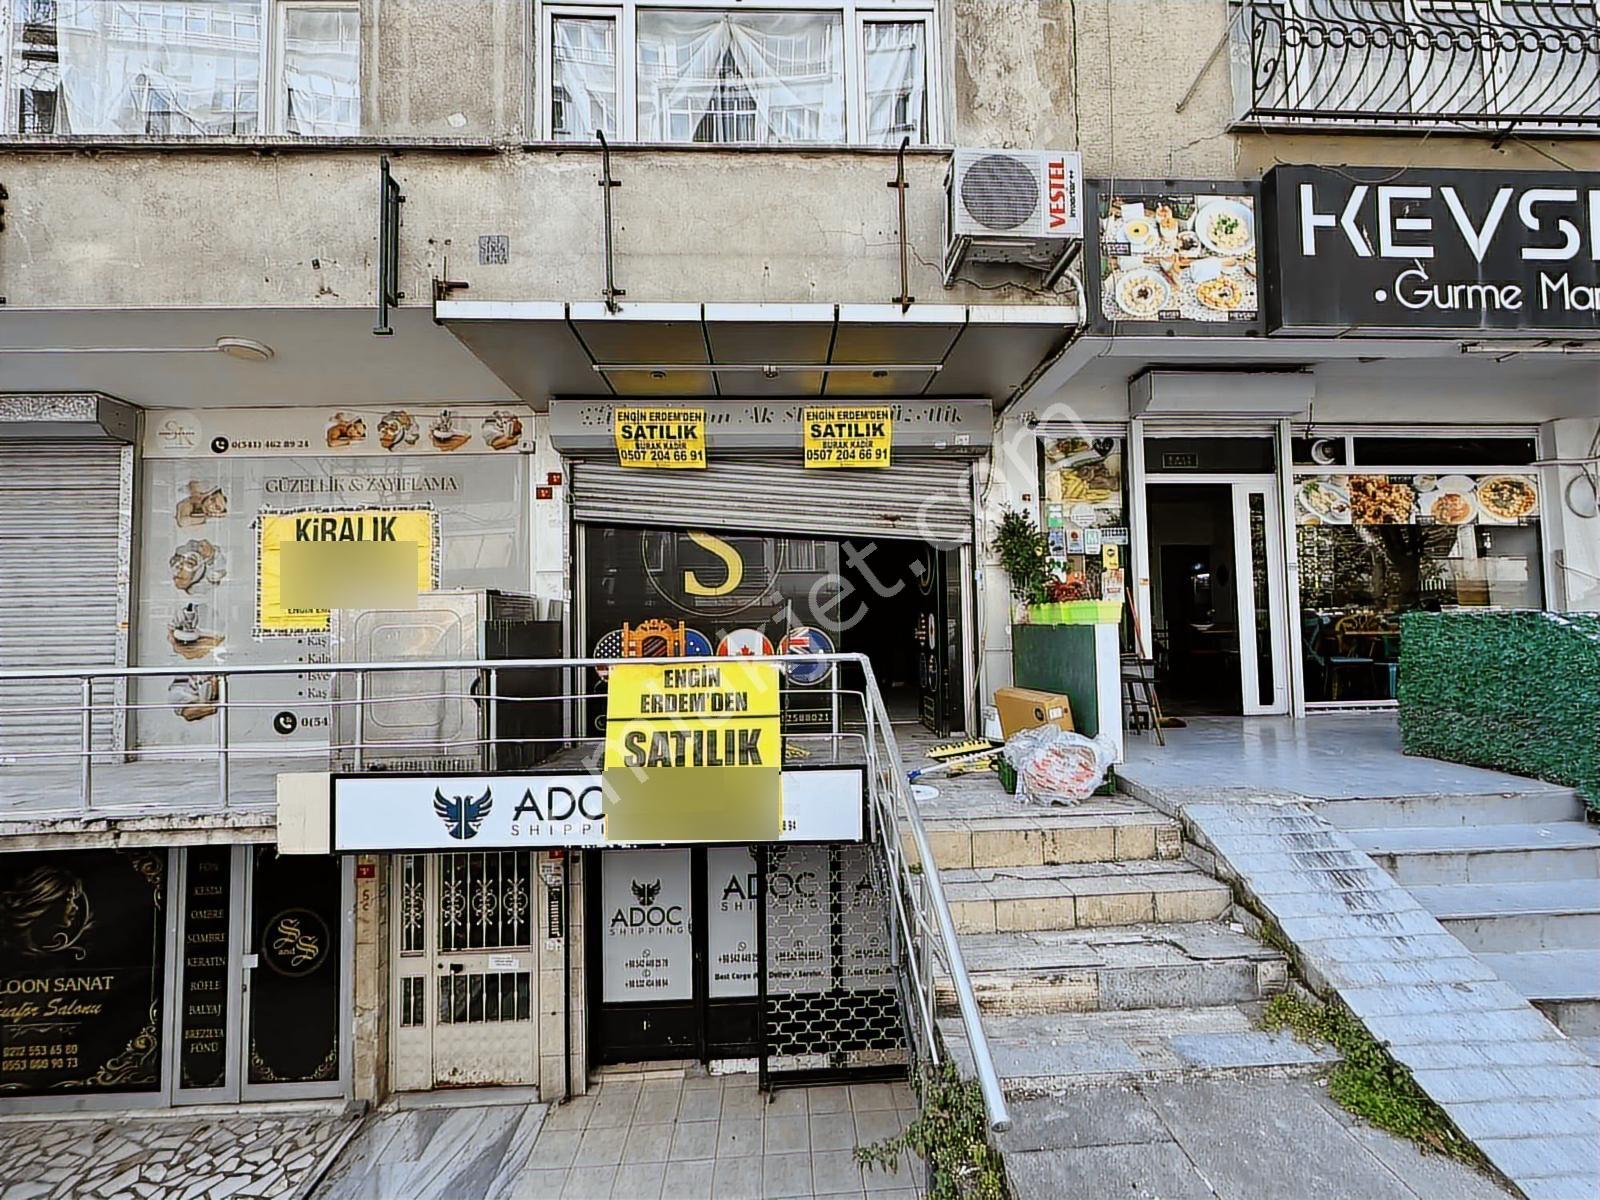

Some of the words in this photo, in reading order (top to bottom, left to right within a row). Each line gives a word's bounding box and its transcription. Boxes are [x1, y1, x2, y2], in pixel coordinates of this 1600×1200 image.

[1048, 158, 1066, 228] VESTEL
[1395, 265, 1523, 309] Gurme
[621, 425, 698, 440] SATILIK
[811, 423, 885, 438] SATILIK
[621, 450, 646, 461] 0507
[651, 451, 670, 461] 204
[674, 452, 687, 461] 66
[691, 451, 703, 461] 91
[807, 449, 832, 460] 0507
[836, 449, 855, 460] 204
[859, 449, 872, 460] 66
[875, 449, 888, 460] 91
[349, 477, 363, 492] &
[664, 665, 720, 689] ENGİN
[640, 692, 748, 714] ERDEM'DEN
[624, 729, 763, 767] SATILIK
[610, 905, 682, 927] ADOC
[609, 926, 684, 936] SHIPPING
[53, 976, 115, 992] SANAT
[43, 998, 103, 1016] Salonu
[28, 1045, 48, 1057] 553
